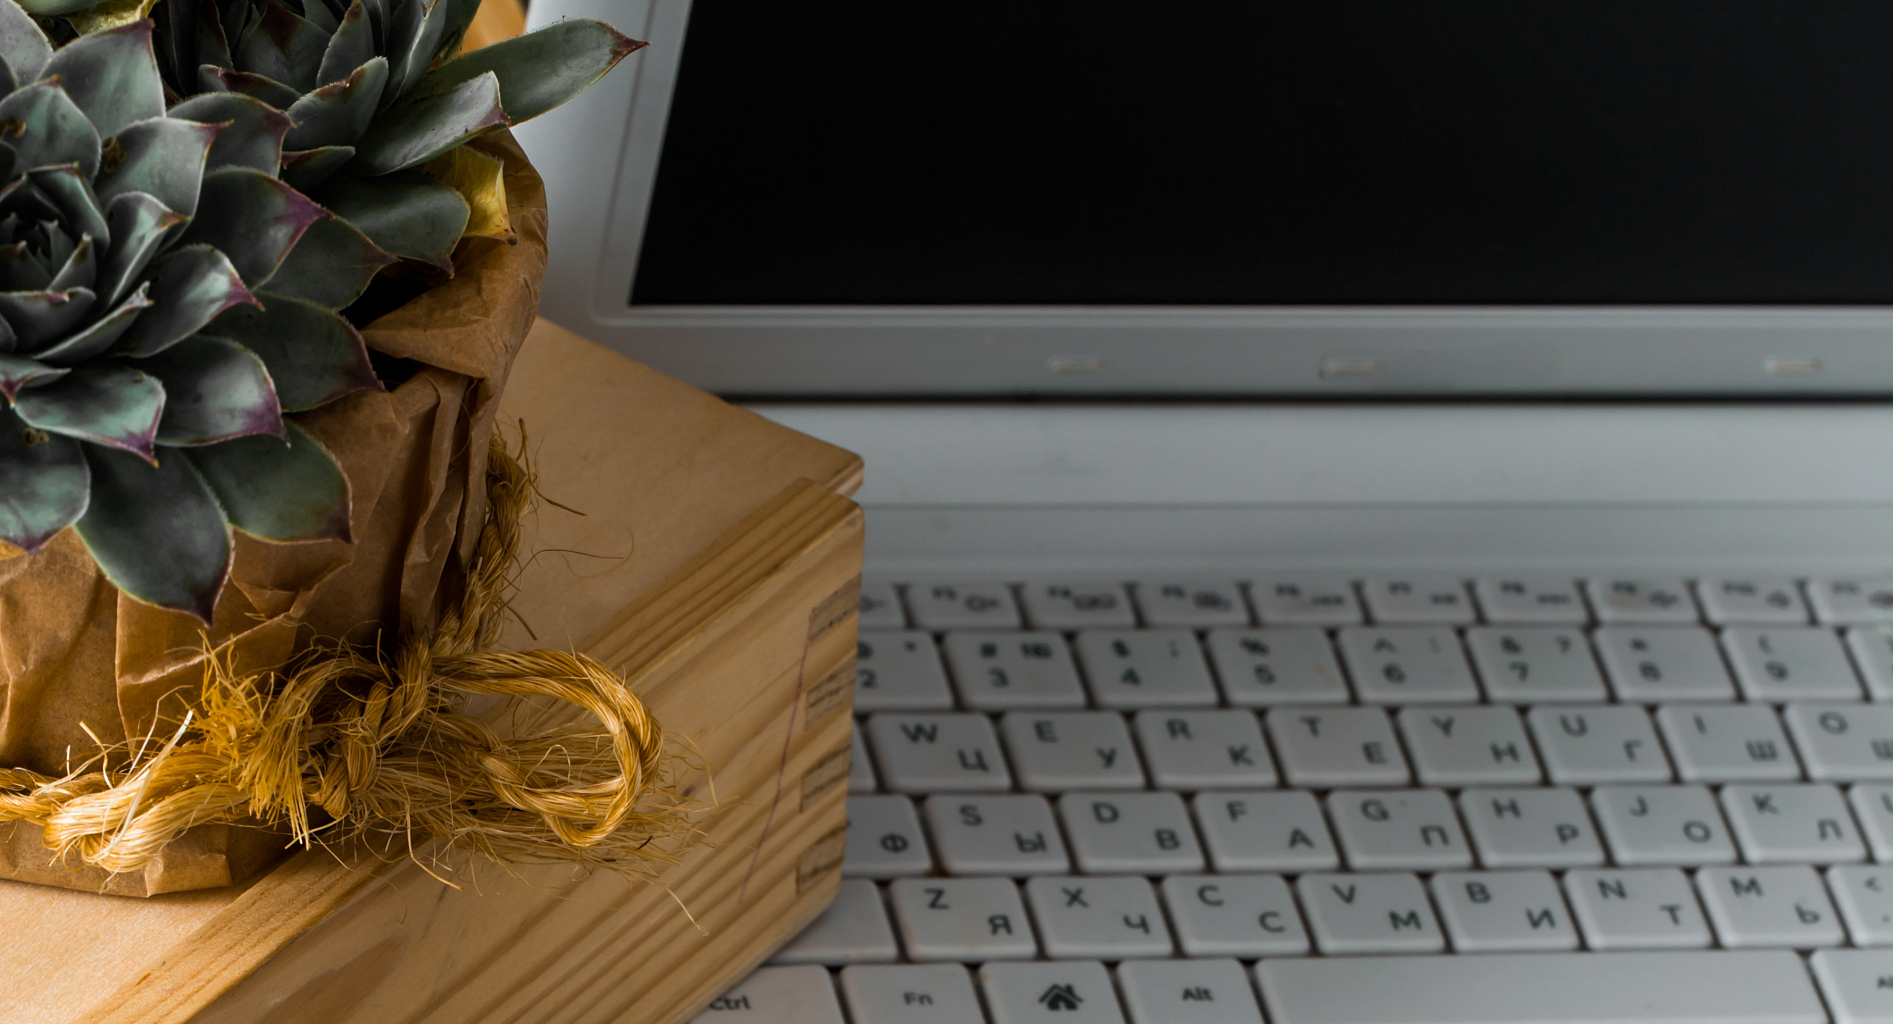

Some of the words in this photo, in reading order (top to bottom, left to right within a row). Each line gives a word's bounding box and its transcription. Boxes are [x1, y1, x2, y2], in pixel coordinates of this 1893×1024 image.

[901, 723, 938, 743] W
[1034, 721, 1057, 742] E
[1166, 719, 1192, 739] R
[1301, 716, 1320, 737] T
[1432, 717, 1454, 737] Y
[1560, 716, 1588, 737] U
[1818, 712, 1848, 734] O
[1092, 802, 1120, 824] D
[1226, 801, 1246, 822] F
[1360, 799, 1390, 821] G
[1491, 799, 1521, 818] H
[1630, 796, 1649, 817] J
[1752, 794, 1778, 814] K
[959, 805, 983, 826] S
[880, 833, 909, 853] Ф
[1062, 887, 1089, 908] X
[1197, 885, 1224, 907] C
[1331, 884, 1356, 905] V
[1464, 881, 1492, 904] B
[1597, 879, 1628, 900] N
[1729, 877, 1763, 897] M
[925, 888, 949, 910] Z
[708, 995, 751, 1011] Ctrl
[903, 992, 933, 1005] Fn
[1182, 986, 1214, 1002] Alt
